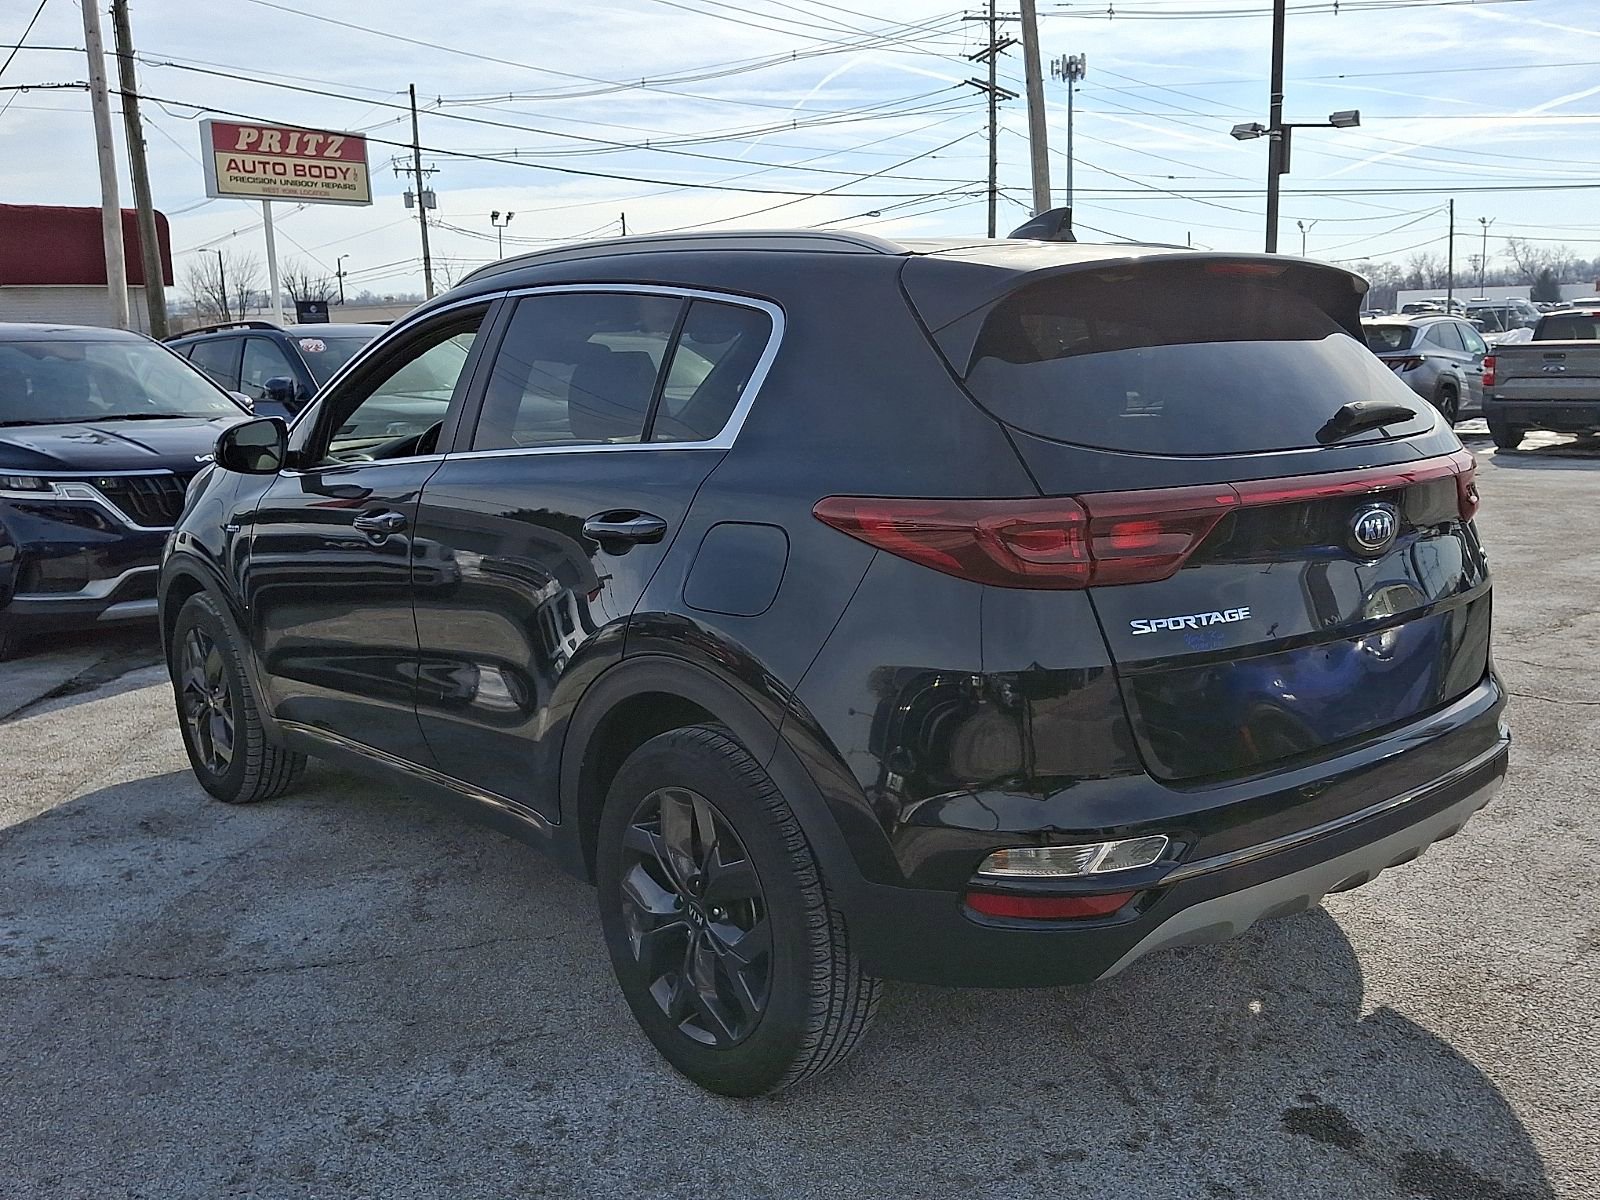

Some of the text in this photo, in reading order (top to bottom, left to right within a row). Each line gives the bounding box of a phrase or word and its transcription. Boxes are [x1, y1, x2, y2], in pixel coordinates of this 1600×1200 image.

[234, 127, 345, 158] PRITZ
[226, 158, 351, 181] AUTO BODY
[229, 175, 357, 191] PRECISION UNIBODY REPAIRS
[1364, 517, 1393, 541] KIA
[1130, 606, 1252, 636] SPORTAGE
